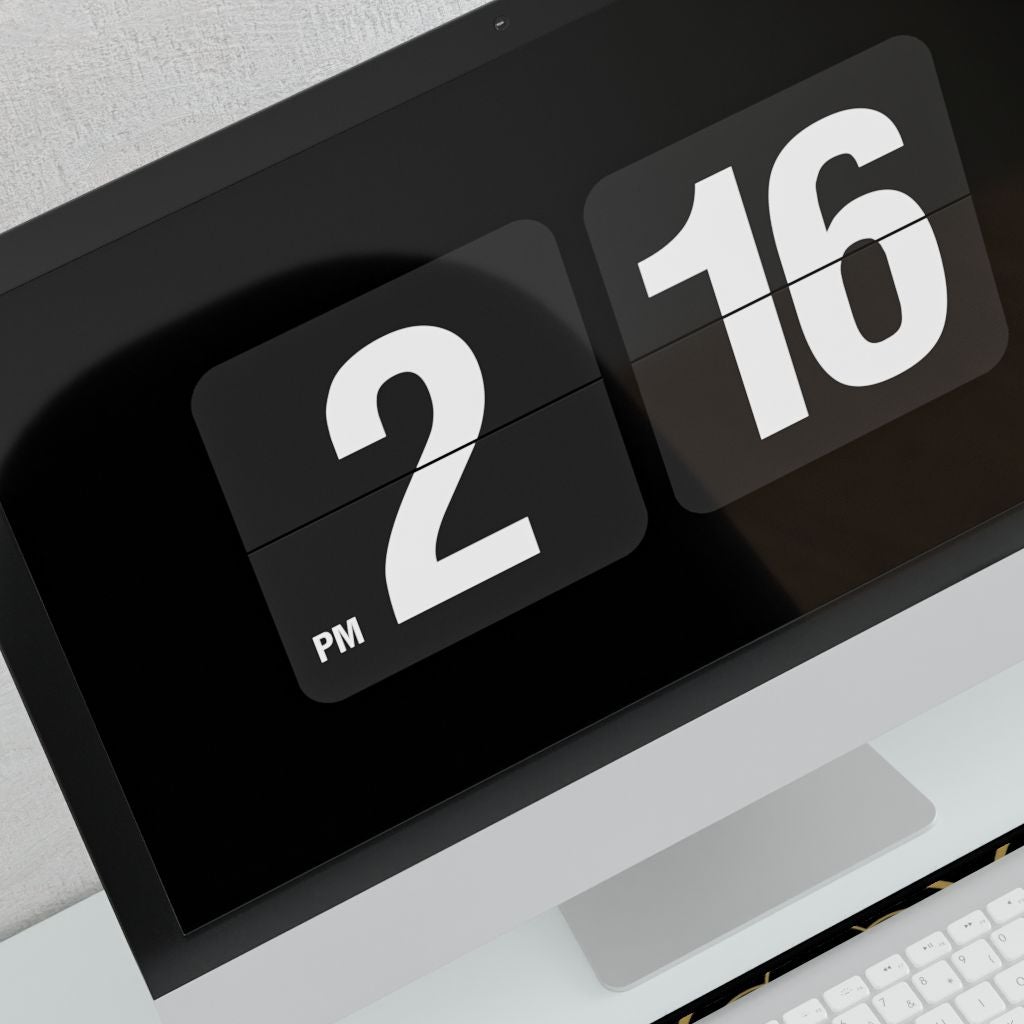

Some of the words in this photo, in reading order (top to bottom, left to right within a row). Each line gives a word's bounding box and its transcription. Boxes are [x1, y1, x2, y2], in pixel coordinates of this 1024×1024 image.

[638, 108, 947, 440] 16
[326, 325, 540, 630] 2
[312, 617, 364, 663] PM
[958, 955, 966, 964] 9
[918, 976, 928, 986] 8
[878, 997, 886, 1007] 7
